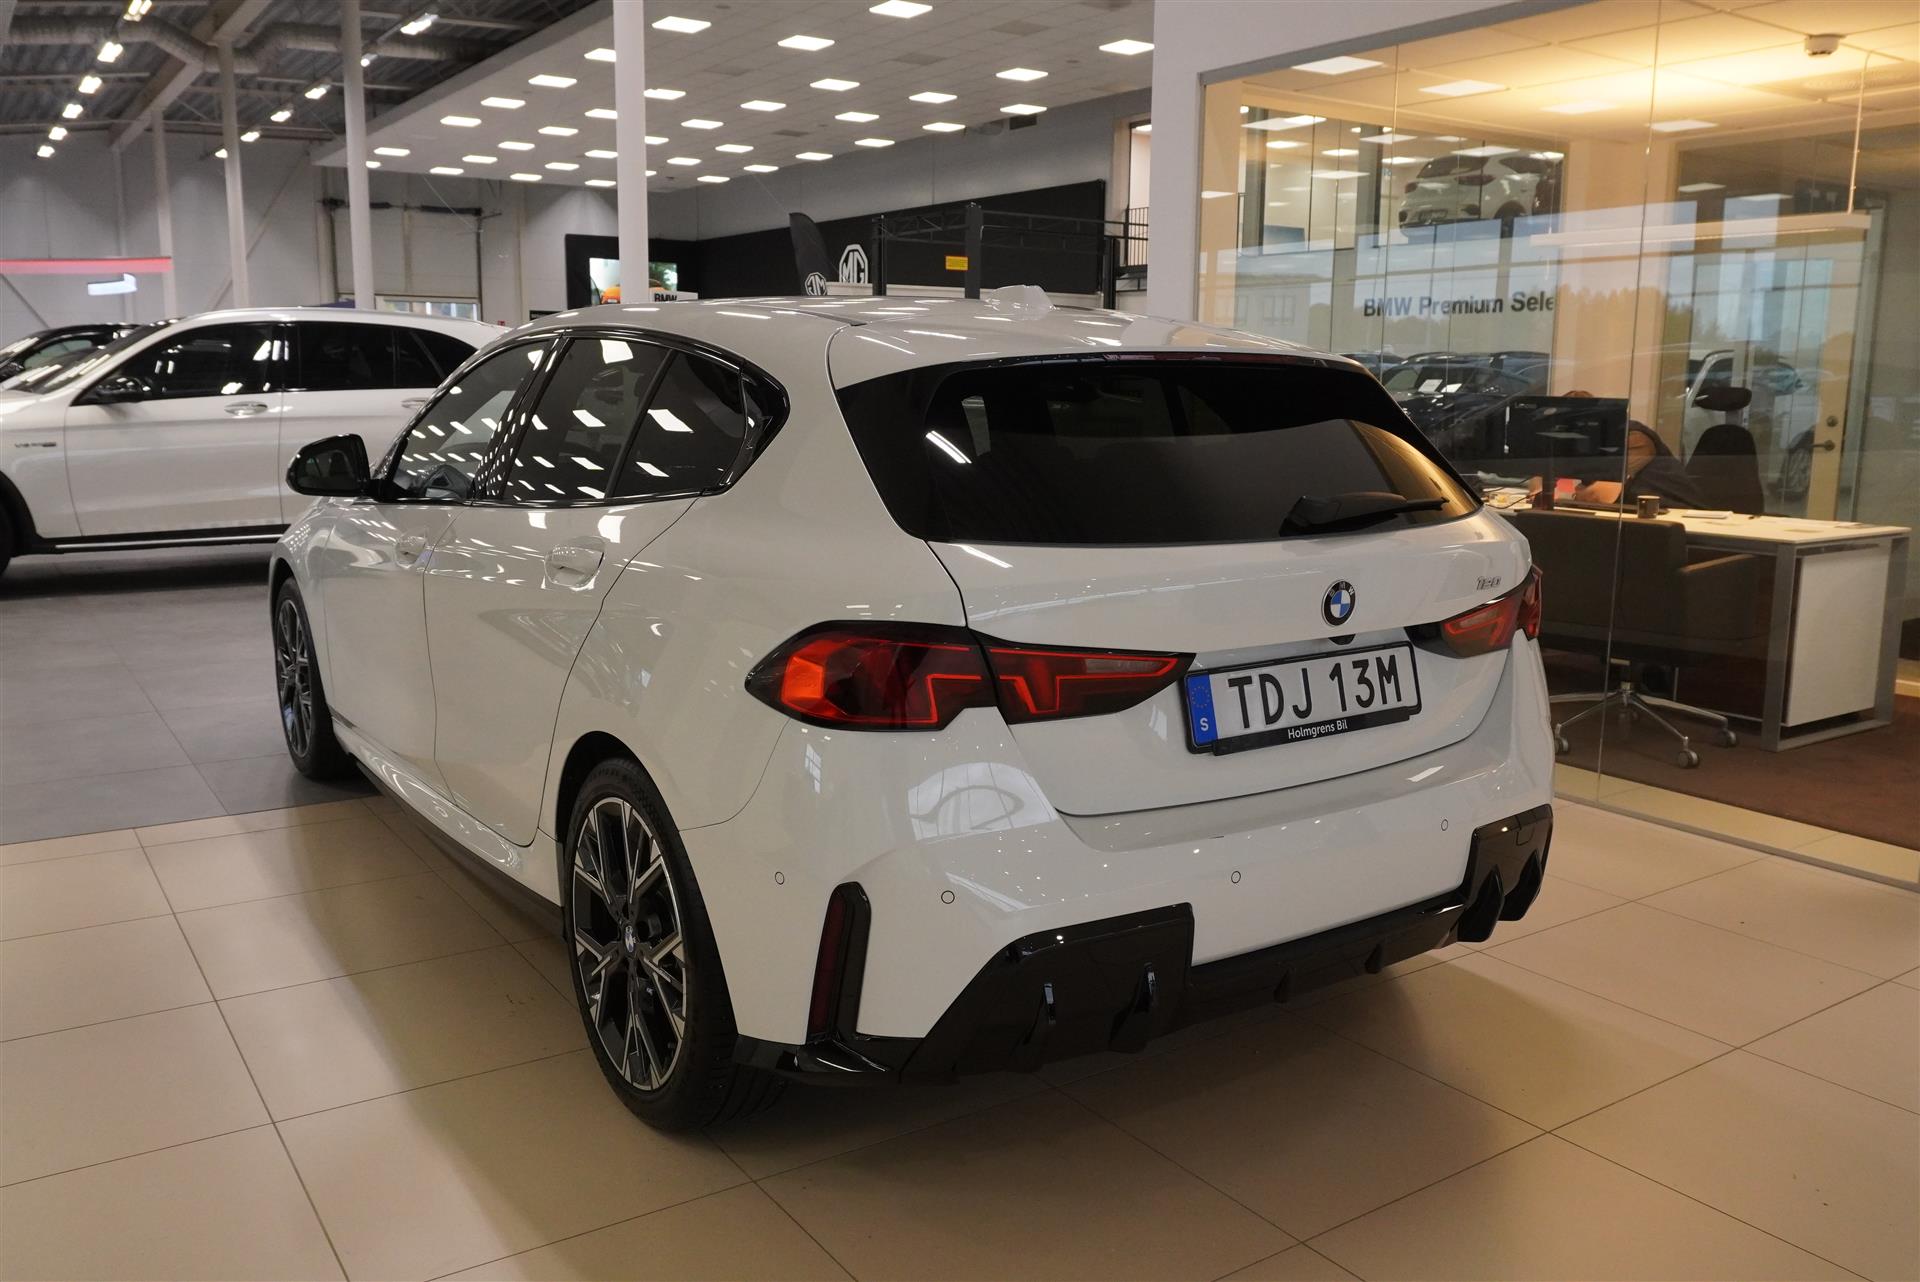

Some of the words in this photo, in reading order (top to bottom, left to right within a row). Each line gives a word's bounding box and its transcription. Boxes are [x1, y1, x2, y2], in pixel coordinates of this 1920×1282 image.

[840, 246, 867, 284] MG
[654, 293, 677, 302] BMW
[1363, 297, 1413, 316] BMW
[1418, 294, 1504, 316] Premium
[1510, 290, 1554, 312] Sele
[1227, 667, 1313, 729] TDJ
[1328, 654, 1403, 713] 13M
[1199, 716, 1210, 732] S
[1287, 723, 1335, 739] Holmgrens
[1336, 719, 1348, 731] Bil
